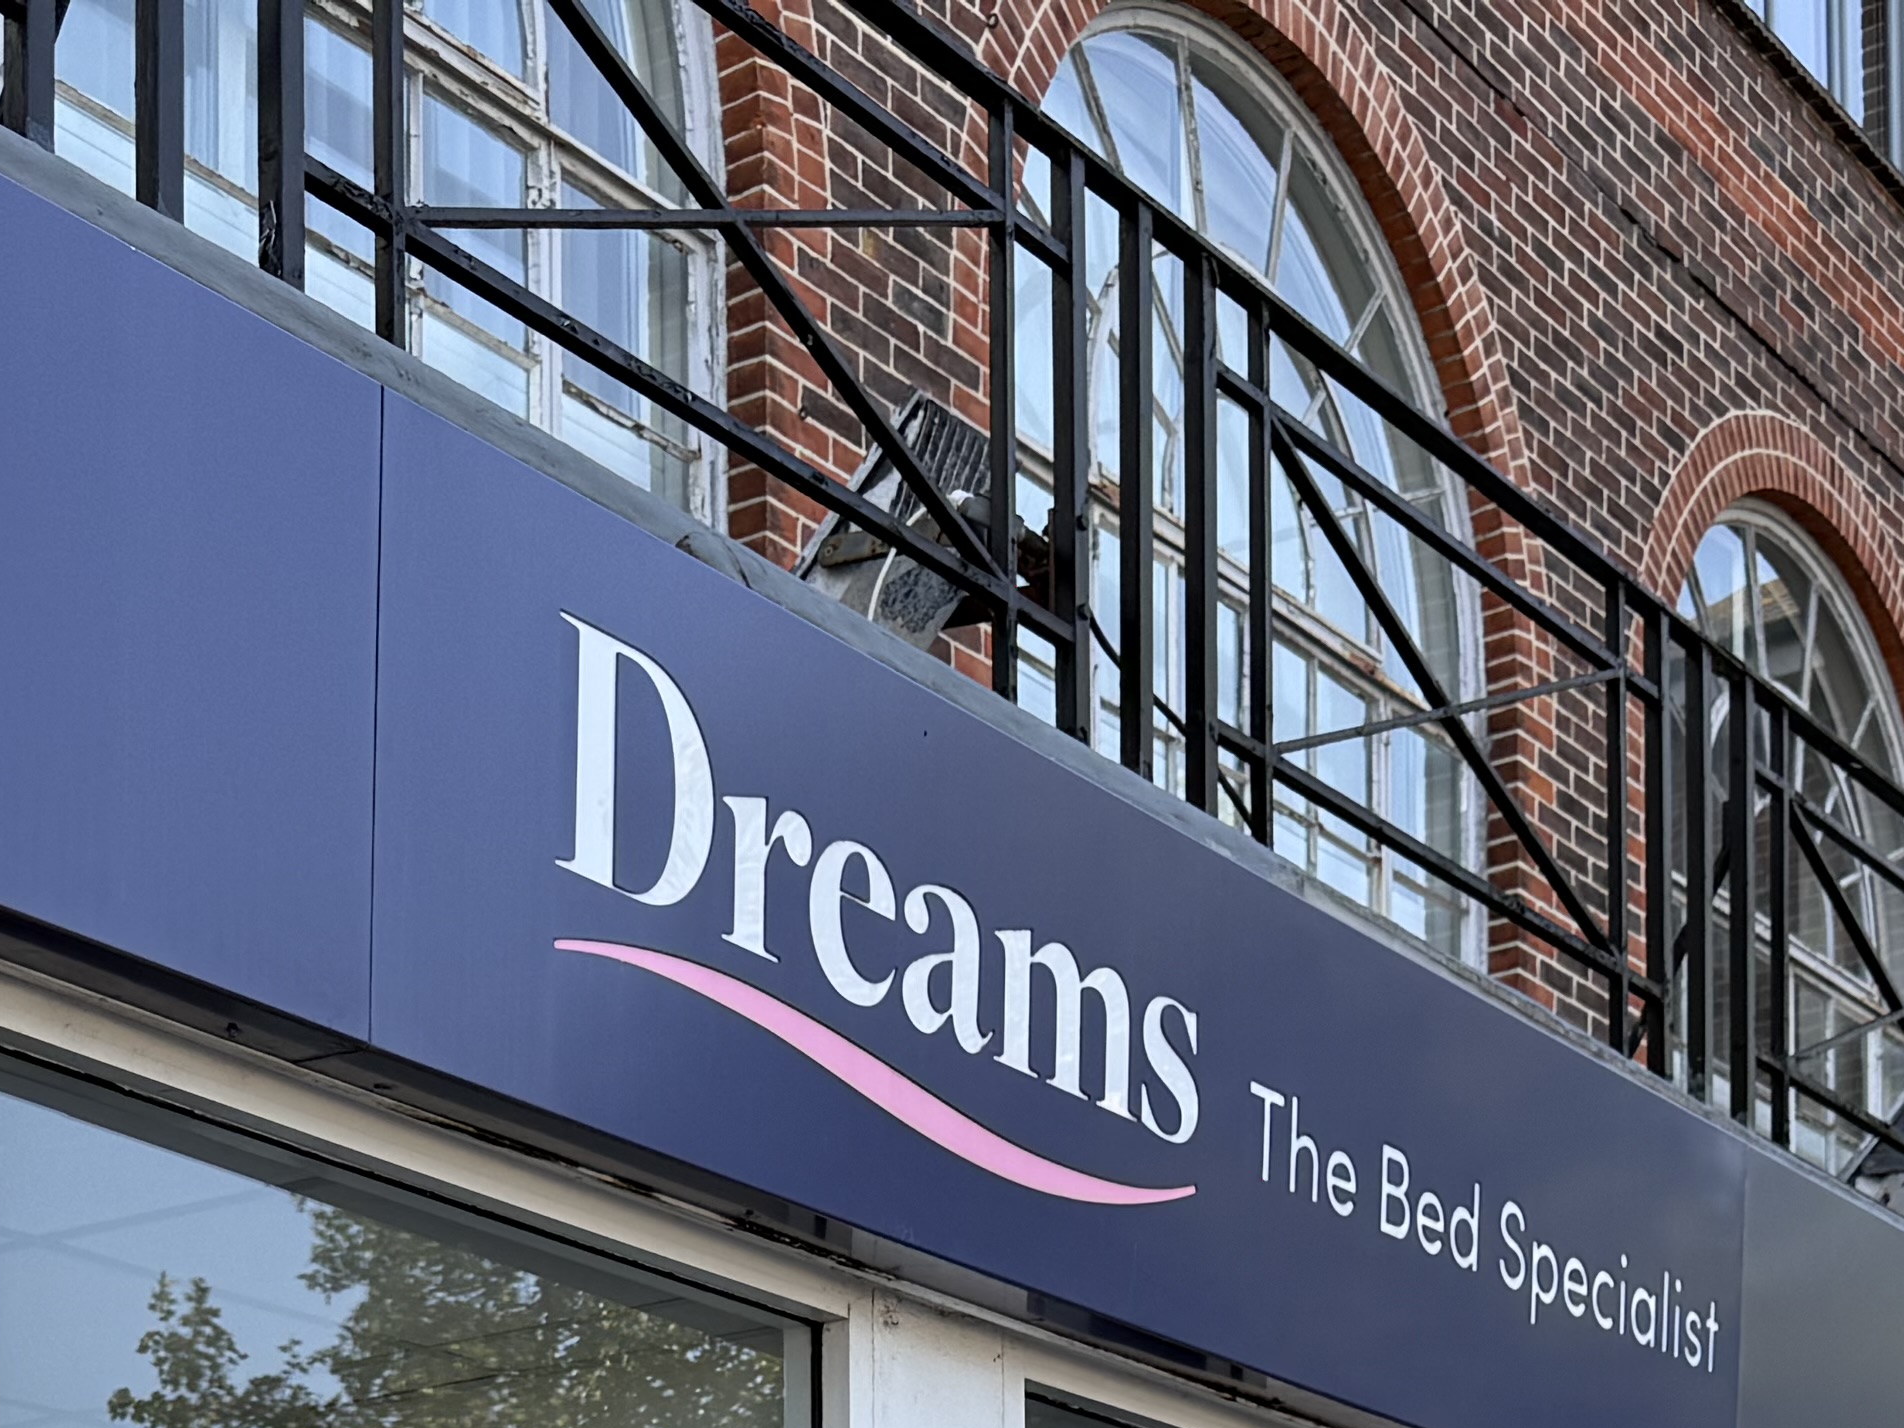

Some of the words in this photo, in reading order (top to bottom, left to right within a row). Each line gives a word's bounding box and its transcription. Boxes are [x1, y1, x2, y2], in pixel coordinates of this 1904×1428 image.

[554, 609, 1201, 1144] Dreams
[1249, 1080, 1358, 1217] The
[1379, 1143, 1480, 1273] Bed
[1499, 1203, 1720, 1374] Specialist
